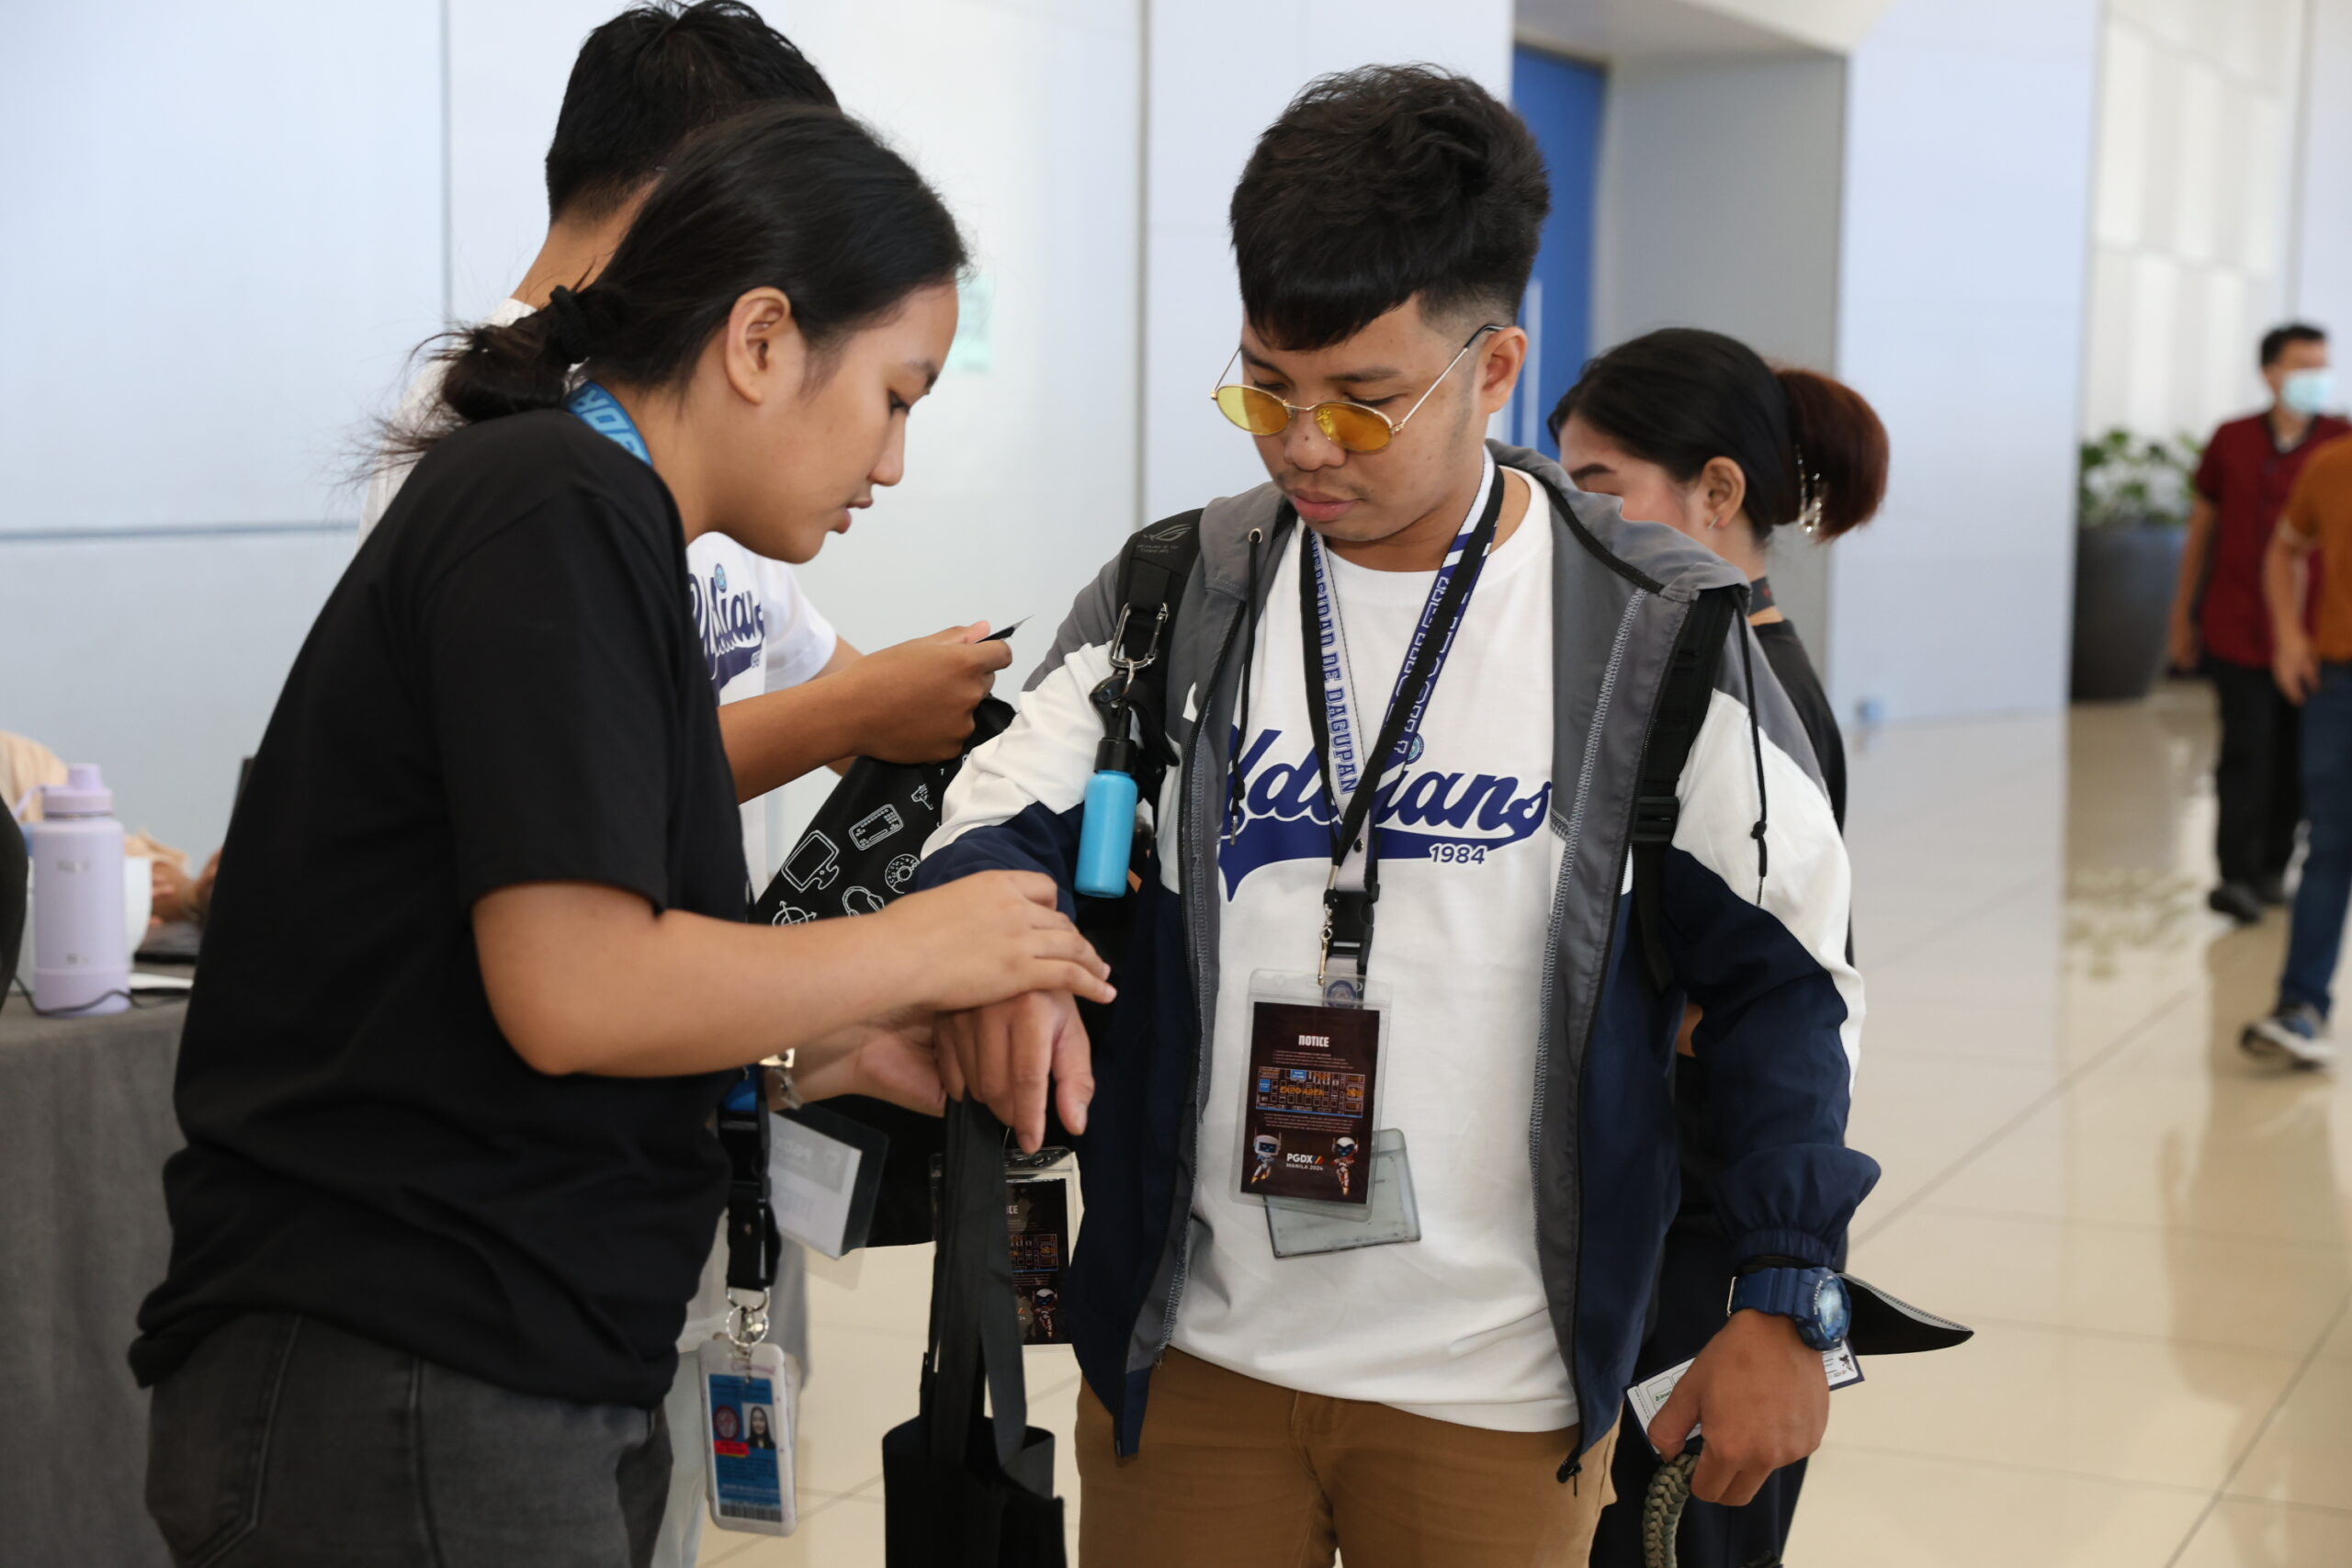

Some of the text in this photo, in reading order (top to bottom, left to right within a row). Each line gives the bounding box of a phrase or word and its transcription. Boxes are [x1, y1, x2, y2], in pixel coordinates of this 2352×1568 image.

[1320, 651, 1340, 682] DE
[1325, 686, 1358, 794] DAGUPAN
[1430, 844, 1486, 864] 1984
[1298, 1034, 1329, 1048] NOTICE
[1286, 1153, 1313, 1164] PGDX
